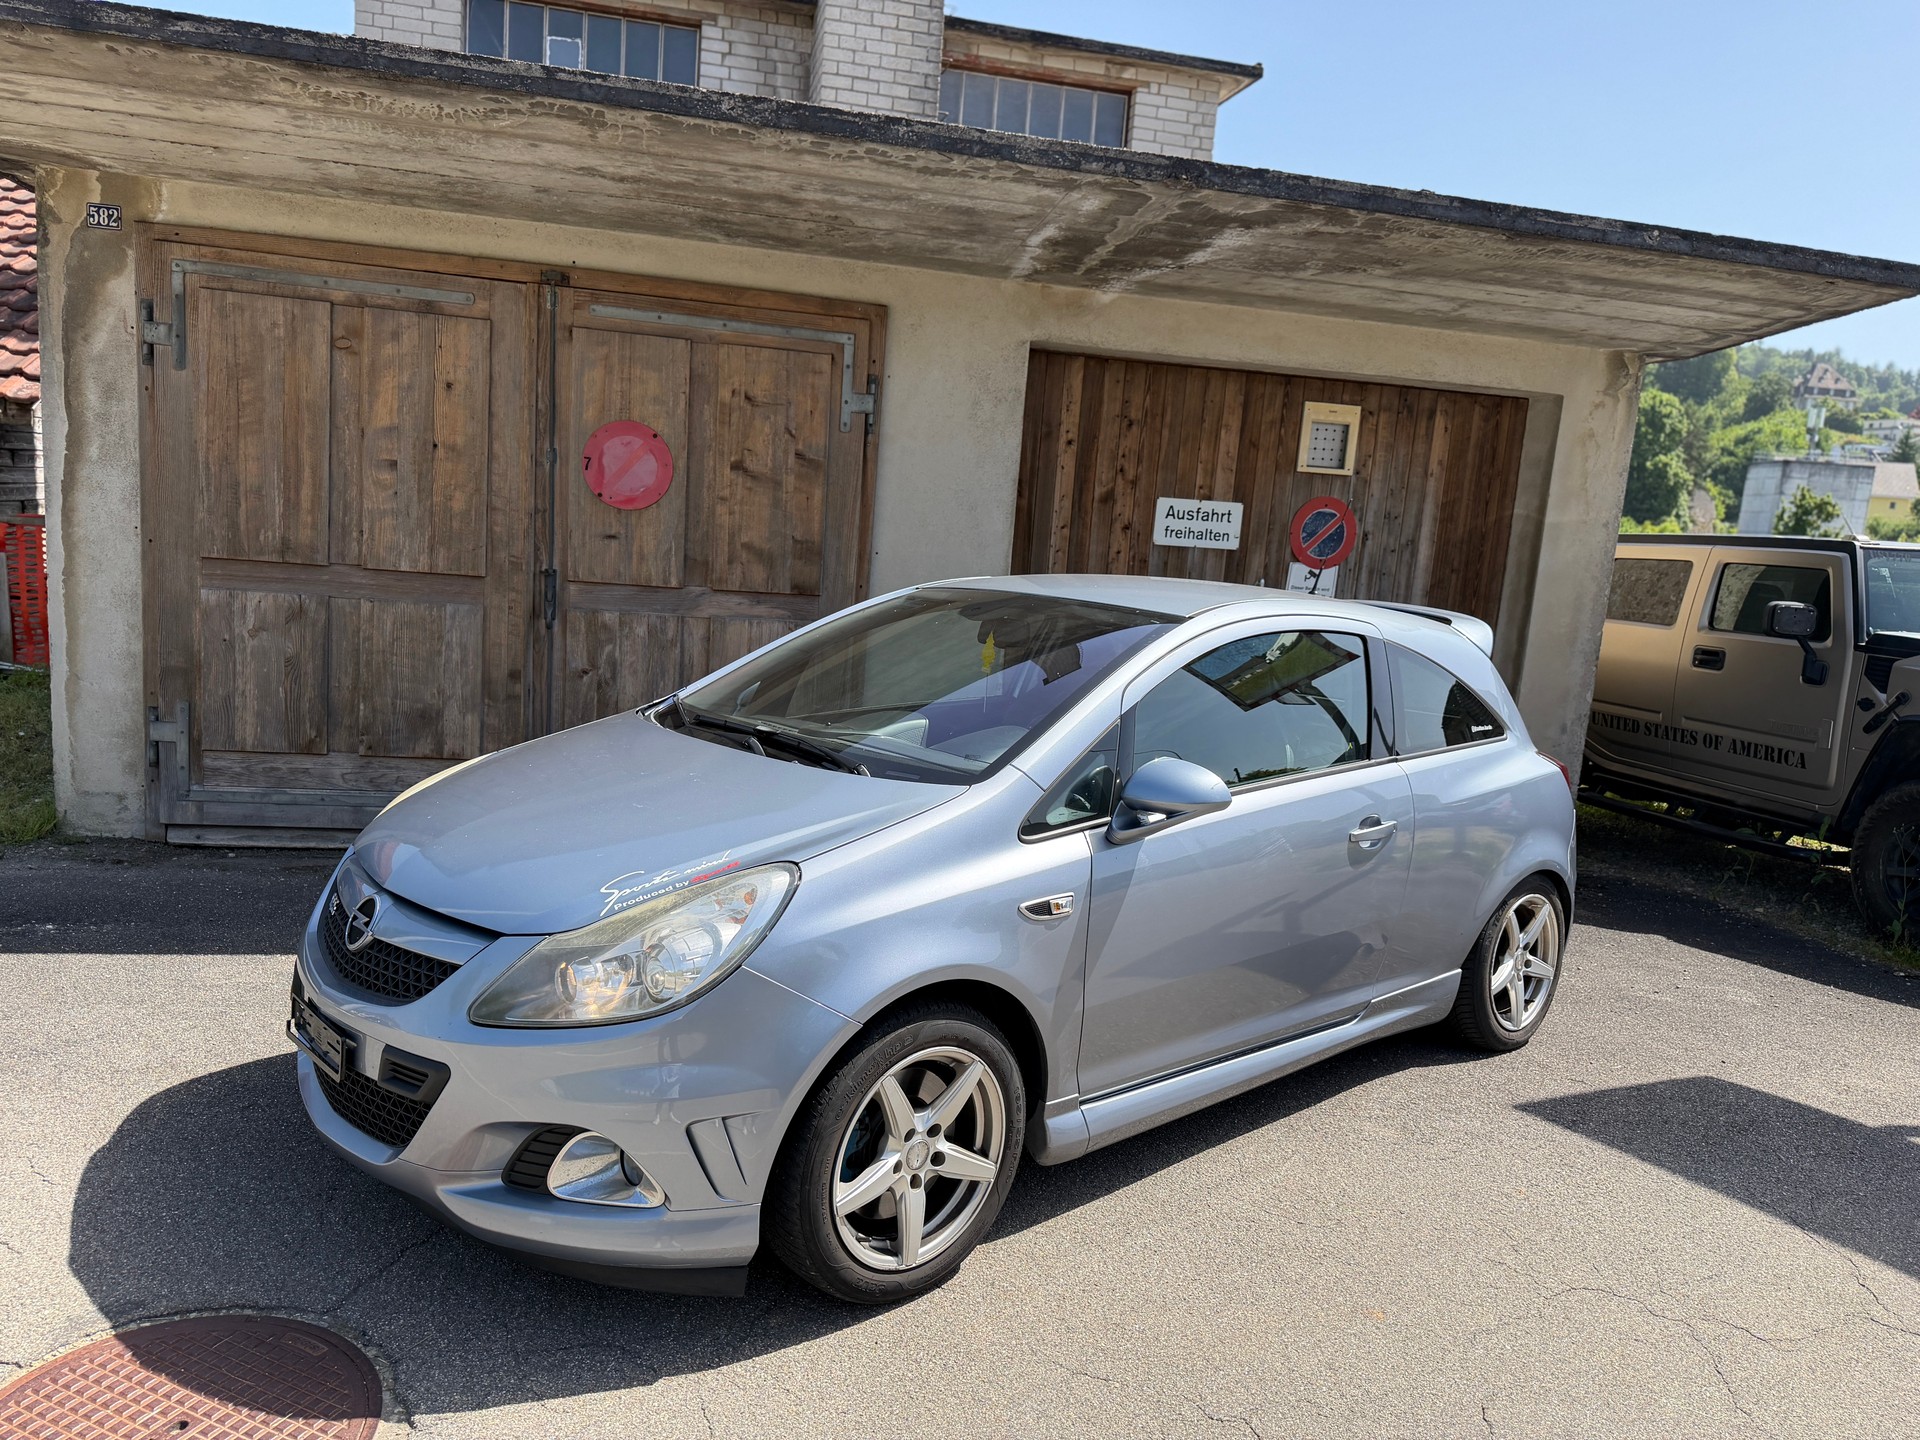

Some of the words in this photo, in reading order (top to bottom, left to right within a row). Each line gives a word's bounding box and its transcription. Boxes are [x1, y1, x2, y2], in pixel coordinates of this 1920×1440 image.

[89, 206, 119, 227] 582
[583, 456, 592, 471] 7
[1164, 505, 1233, 524] Ausfahrt
[1164, 525, 1230, 542] freihalten
[1591, 711, 1641, 734] UNITED
[1644, 721, 1698, 746] STATES
[1702, 732, 1724, 751] OF
[1727, 738, 1808, 770] AMERICA
[614, 885, 674, 911] Produced
[676, 880, 690, 889] by
